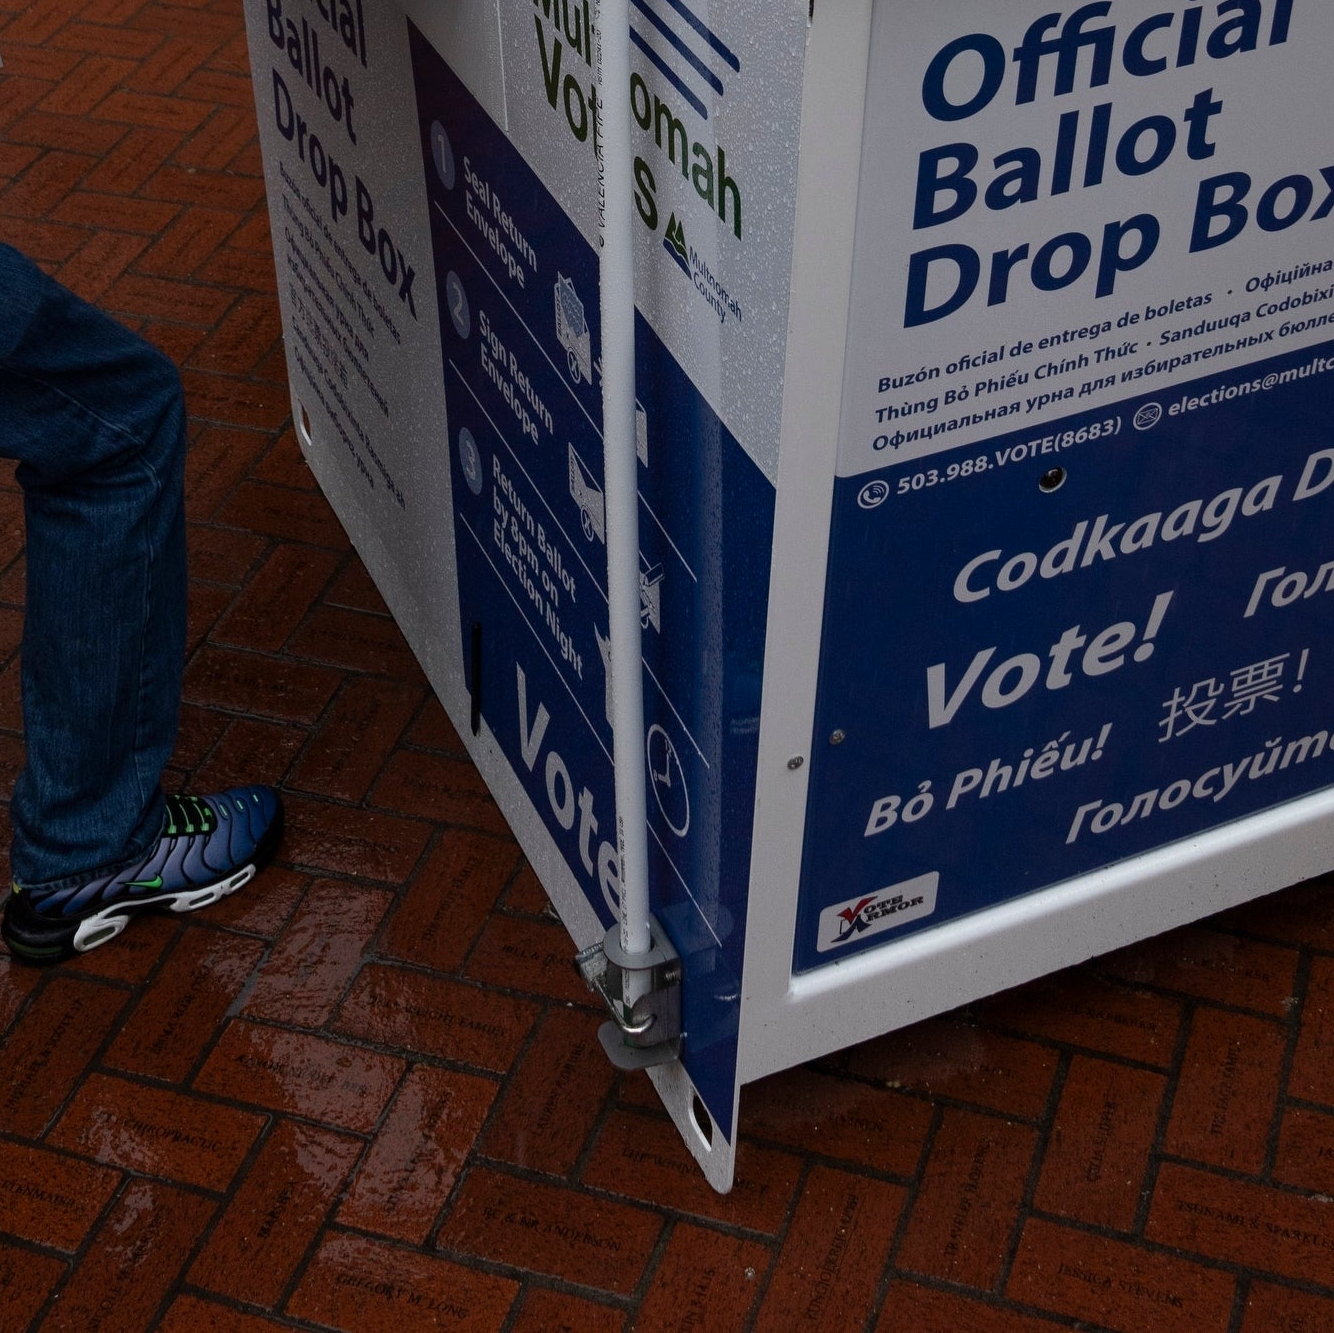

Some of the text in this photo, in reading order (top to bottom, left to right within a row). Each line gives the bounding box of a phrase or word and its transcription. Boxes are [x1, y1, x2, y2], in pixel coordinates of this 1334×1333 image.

[436, 127, 447, 177] 1
[535, 13, 658, 230] Vots
[912, 87, 1223, 230] Ballot
[271, 63, 417, 322] Drop Box
[462, 152, 537, 274] Seal Return
[465, 188, 525, 296] Envelope
[597, 144, 608, 229] VALENCIA
[449, 273, 464, 329] 2
[688, 246, 743, 322] Multnomah
[692, 273, 727, 324] County
[903, 213, 1160, 328] Drop
[1159, 307, 1251, 347] Sanduuqa
[1245, 259, 1333, 294] Офіційна
[477, 303, 553, 439] Sign Return
[479, 338, 539, 457] Envelope
[872, 402, 1020, 452] Официальная
[1025, 387, 1075, 415] урна
[1078, 374, 1116, 398] для
[1120, 331, 1274, 384] избирательных
[875, 341, 1138, 424] Thùng Bỏ Phiếu Chính Thức
[878, 293, 1212, 393] Buzón oficial de entrega de boletas
[463, 433, 477, 489] 3
[896, 416, 1123, 496] 503.988.VOTE(8683)
[491, 450, 576, 607] Return Ballot
[492, 482, 558, 610] by 8pm on
[952, 473, 1278, 604] Codkaaga
[492, 512, 583, 690] Election Night
[926, 591, 1174, 730] Vote!
[516, 661, 621, 924] Vote
[863, 723, 1113, 838] Bỏ Phiếu!
